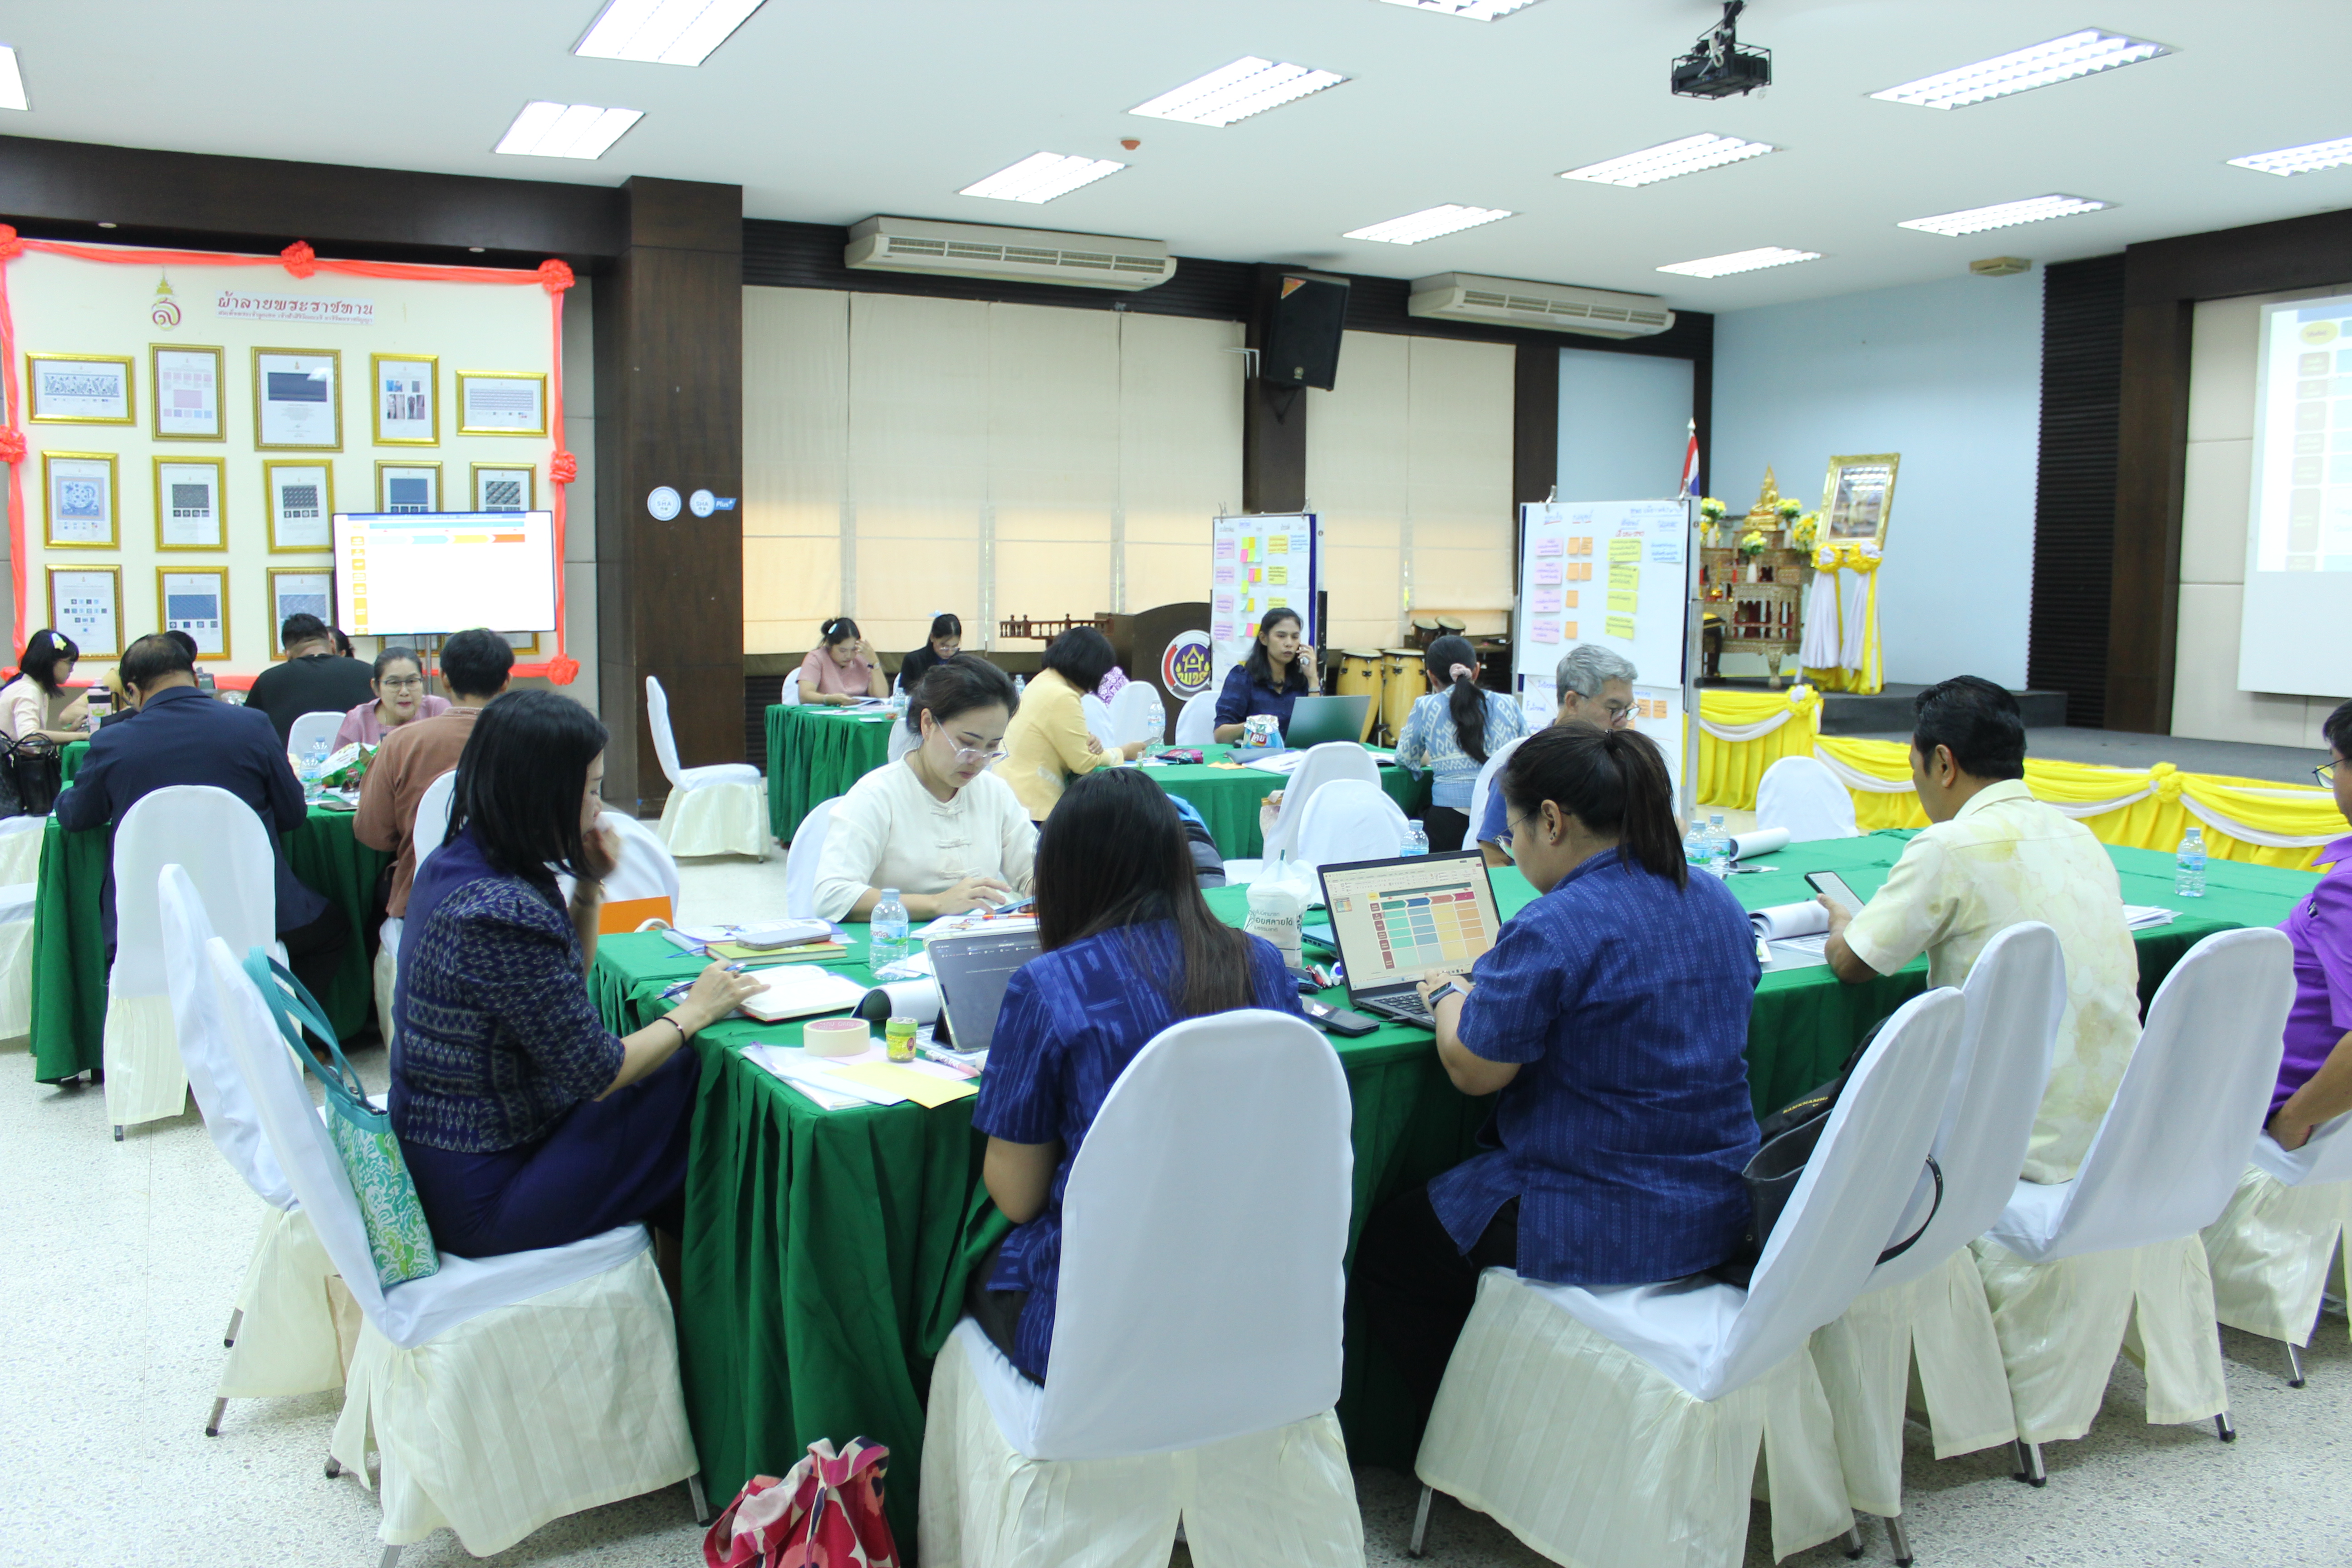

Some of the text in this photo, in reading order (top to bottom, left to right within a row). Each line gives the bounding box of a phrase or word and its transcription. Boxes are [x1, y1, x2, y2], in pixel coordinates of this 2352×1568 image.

[218, 290, 373, 315] ผ้าลายพระราชทาน
